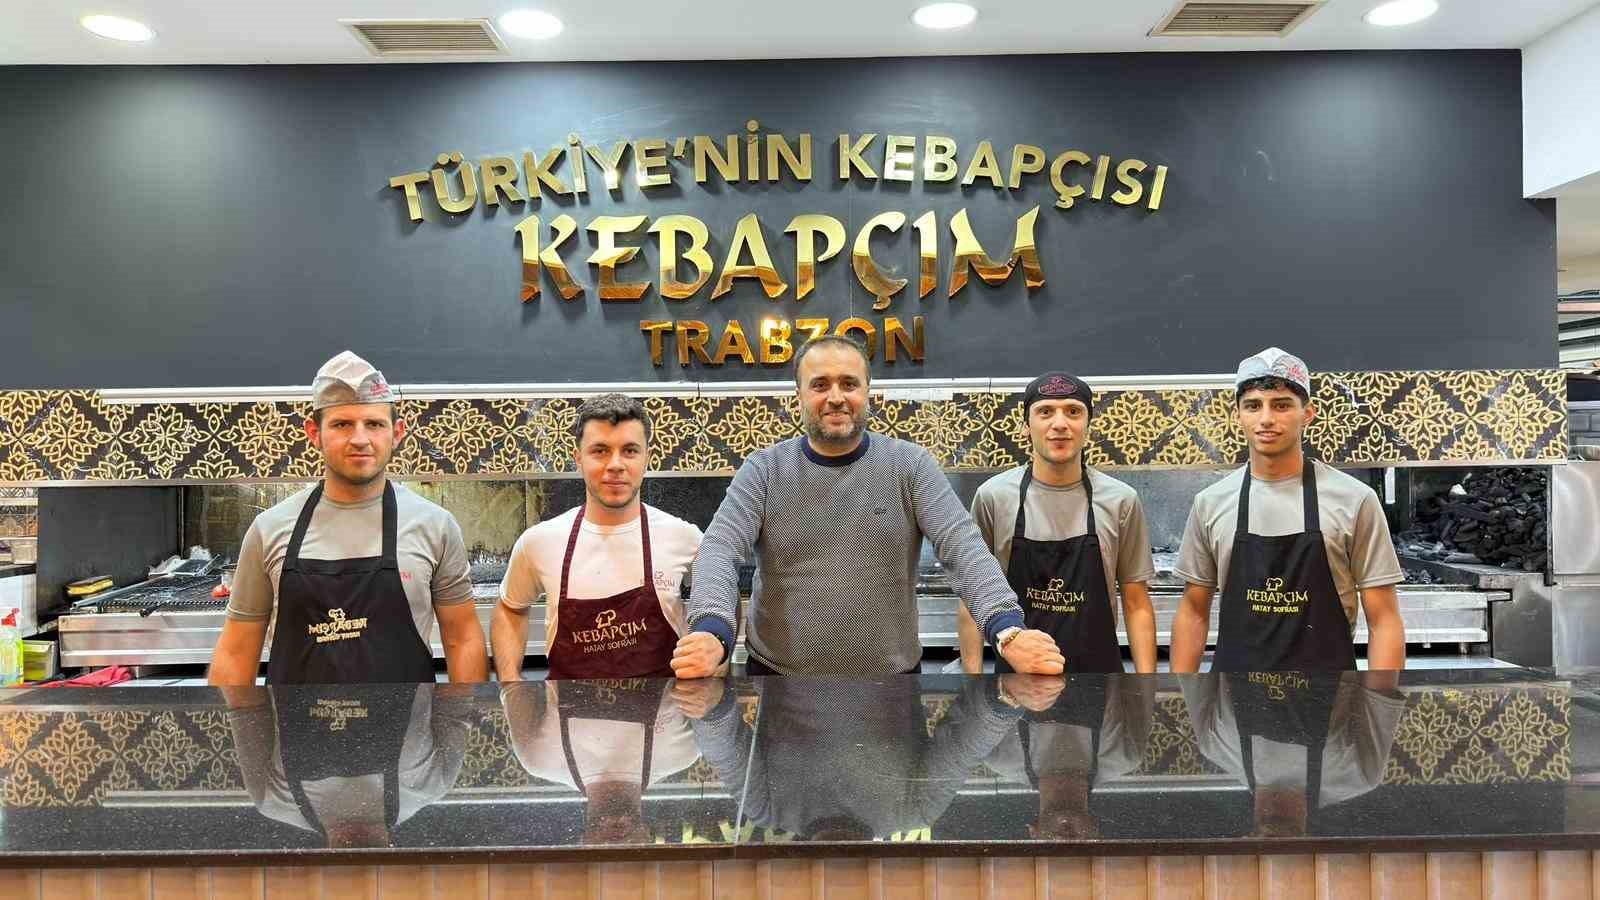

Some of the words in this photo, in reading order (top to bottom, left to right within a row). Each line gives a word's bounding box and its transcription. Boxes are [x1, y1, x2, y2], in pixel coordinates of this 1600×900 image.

[389, 119, 812, 223] TÜRKİYE'NİN
[838, 133, 1168, 211] KEBAPÇISI
[514, 204, 1047, 310] KEBAPÇIM
[1026, 588, 1084, 604] KEBAPÇIM
[1247, 588, 1309, 606] KEBAPÇIM
[572, 617, 648, 644] KEBAPÇIM
[583, 643, 606, 654] HATAY
